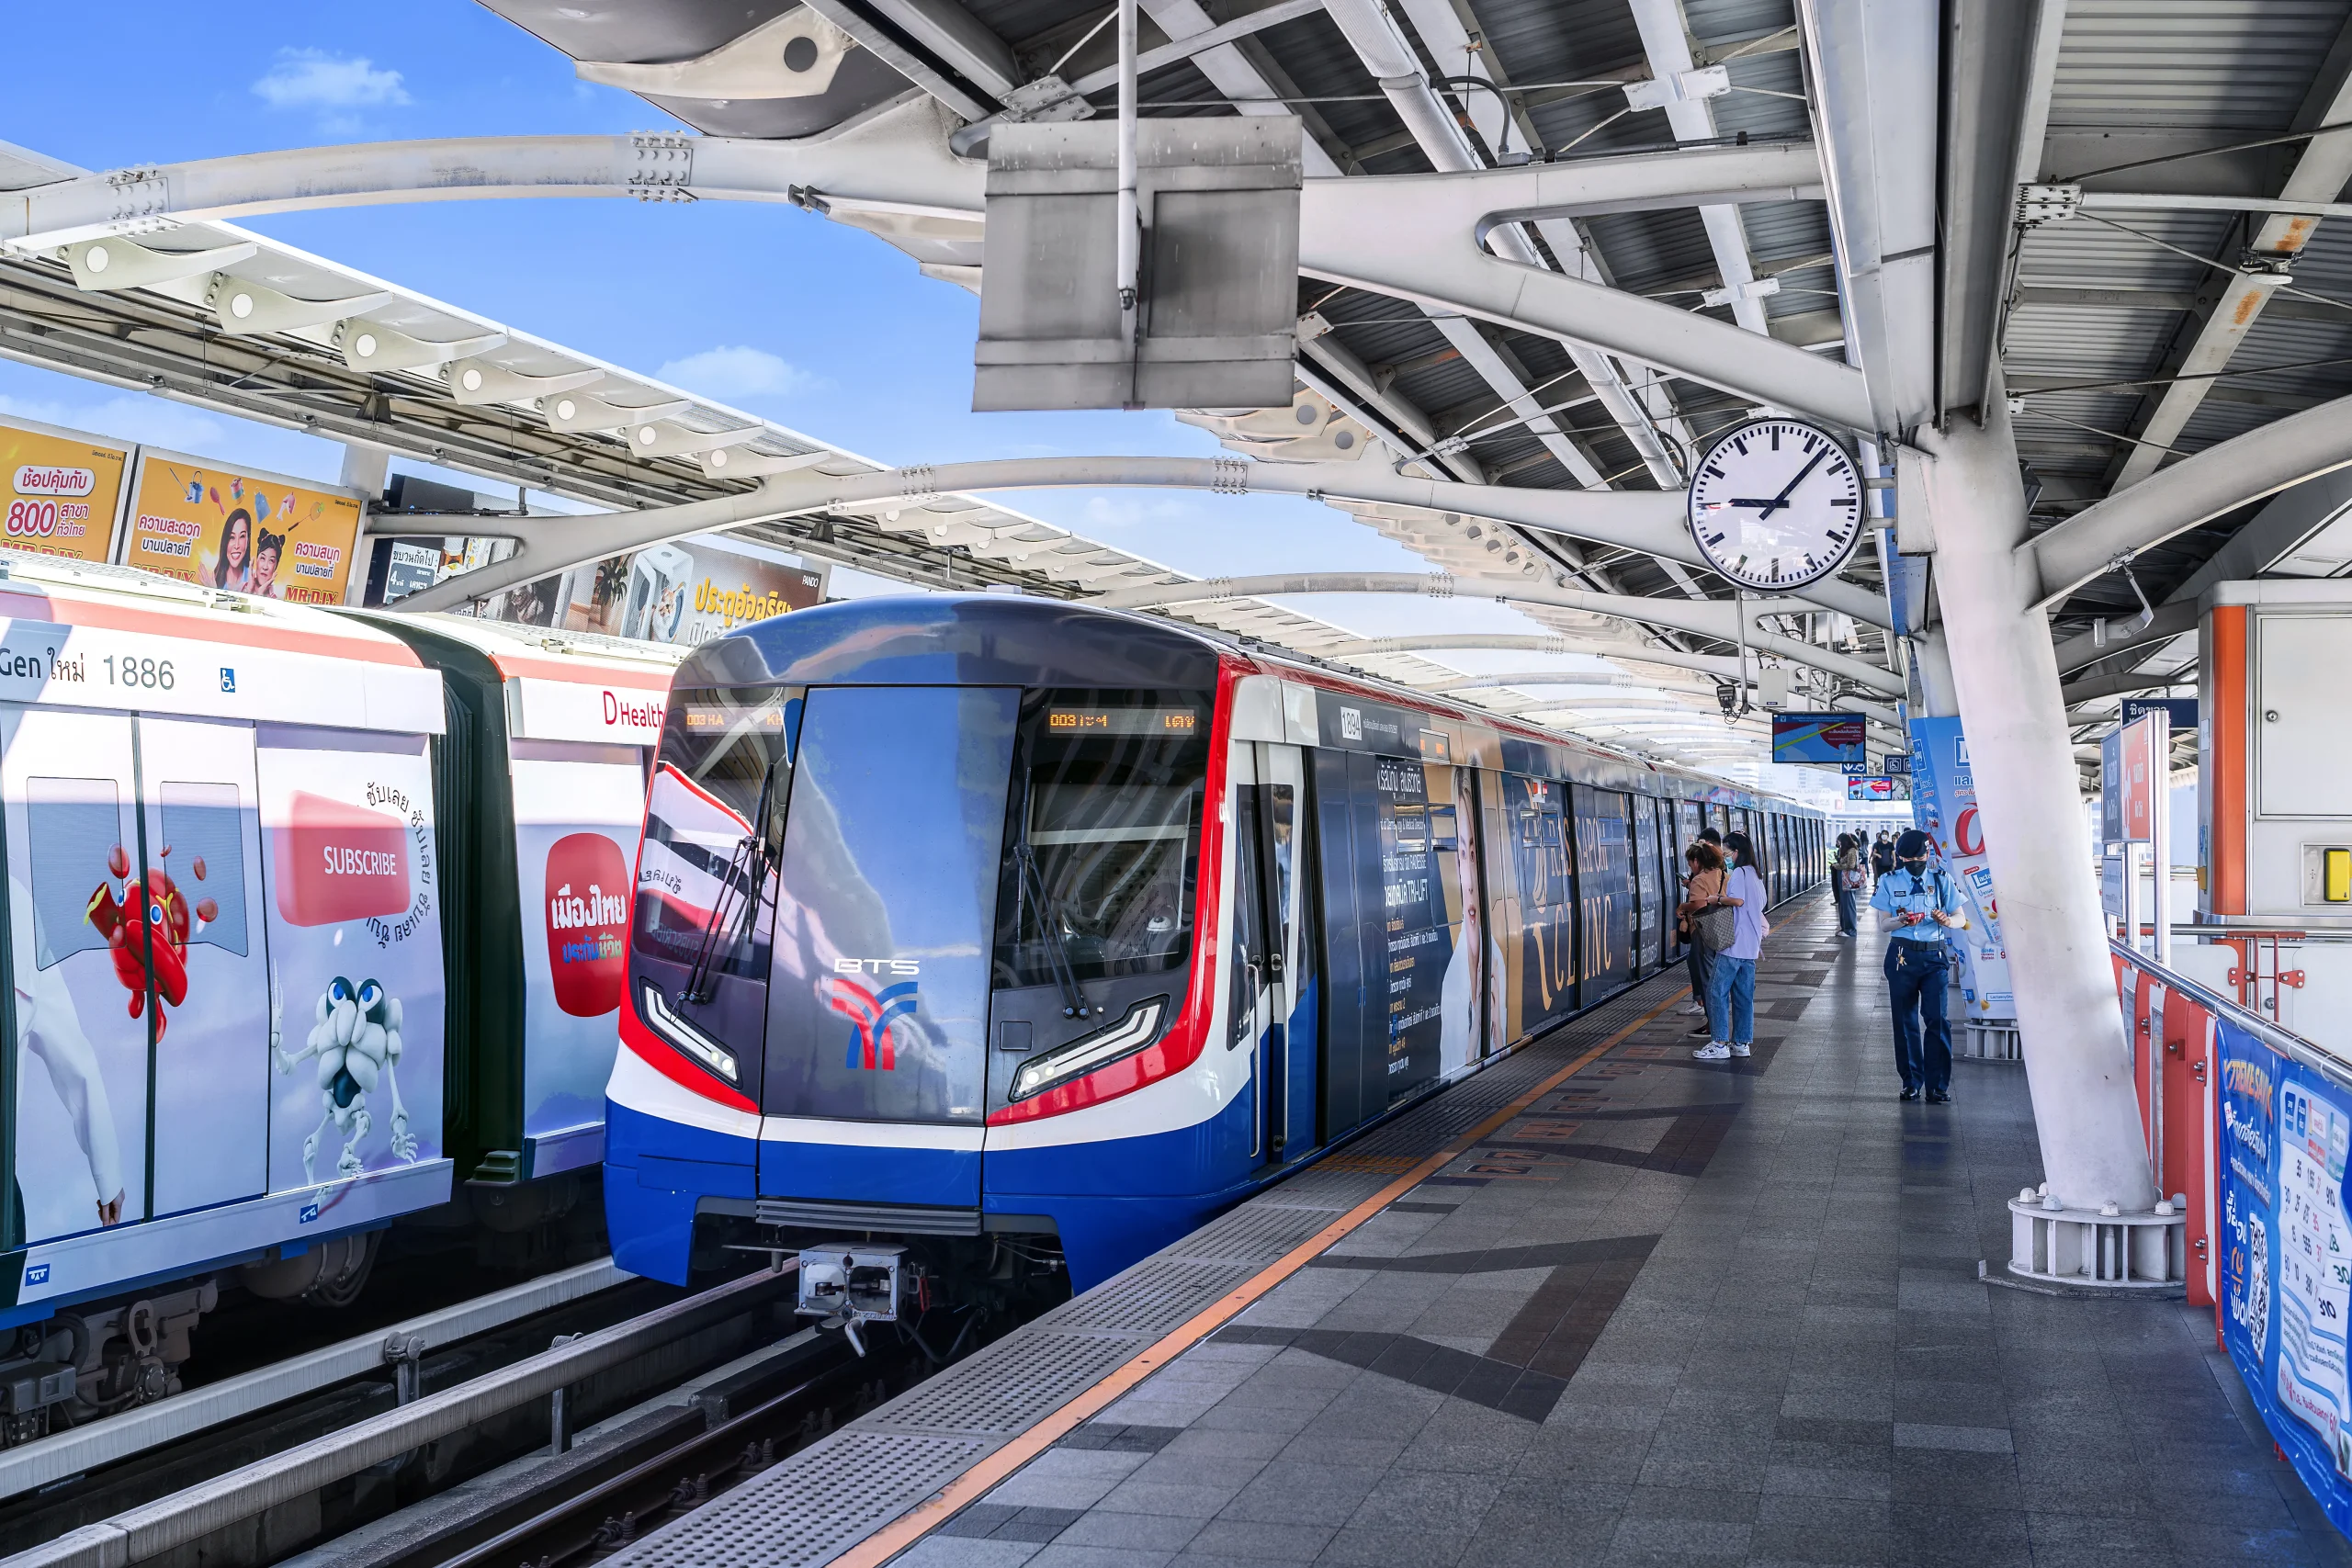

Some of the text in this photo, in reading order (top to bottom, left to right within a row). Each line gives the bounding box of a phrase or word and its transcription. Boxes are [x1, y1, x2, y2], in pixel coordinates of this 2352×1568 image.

[22, 468, 87, 493] ช้อปคุ้มกับ
[6, 502, 57, 535] 800
[61, 503, 88, 519] สาขา
[56, 520, 85, 536] ทั่วไทย
[139, 514, 200, 538] ความสะดวก
[141, 537, 192, 558] บานปลายที่
[295, 542, 341, 563] ความสนุก
[296, 563, 334, 579] บานปลายที่
[390, 571, 397, 585] 4
[103, 655, 175, 691] 1886
[1341, 712, 1361, 739] 1894
[323, 845, 397, 876] SUBSCRIBE
[551, 883, 627, 930] เมืองไทย
[562, 931, 623, 964] ประกันชีวิต
[833, 958, 921, 975] BTS
[2334, 1265, 2350, 1285] 30
[2319, 1297, 2336, 1319] 310
